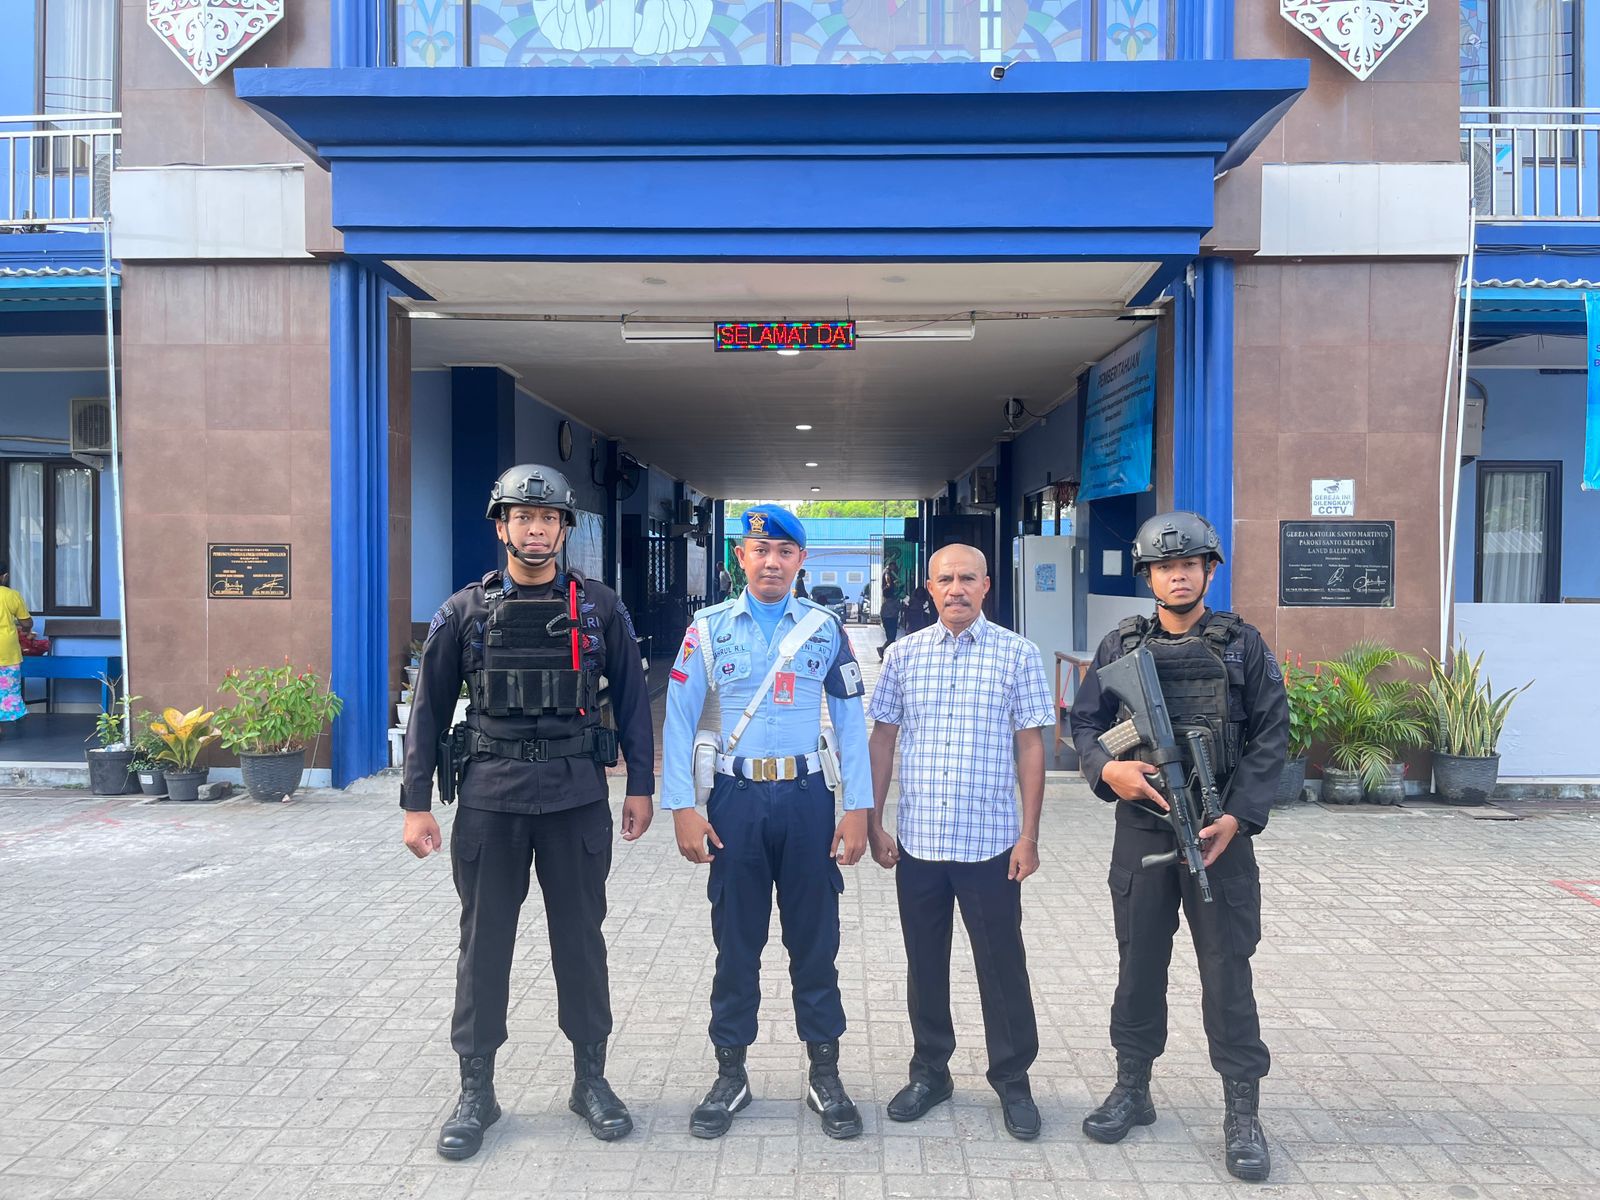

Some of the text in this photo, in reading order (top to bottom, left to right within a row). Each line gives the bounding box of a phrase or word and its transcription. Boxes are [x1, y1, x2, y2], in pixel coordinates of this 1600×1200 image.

[721, 327, 812, 344] SELAMAT
[1097, 350, 1141, 390] PEMBERITAHUAN
[1318, 506, 1347, 514] CCTV
[840, 661, 861, 695] P
